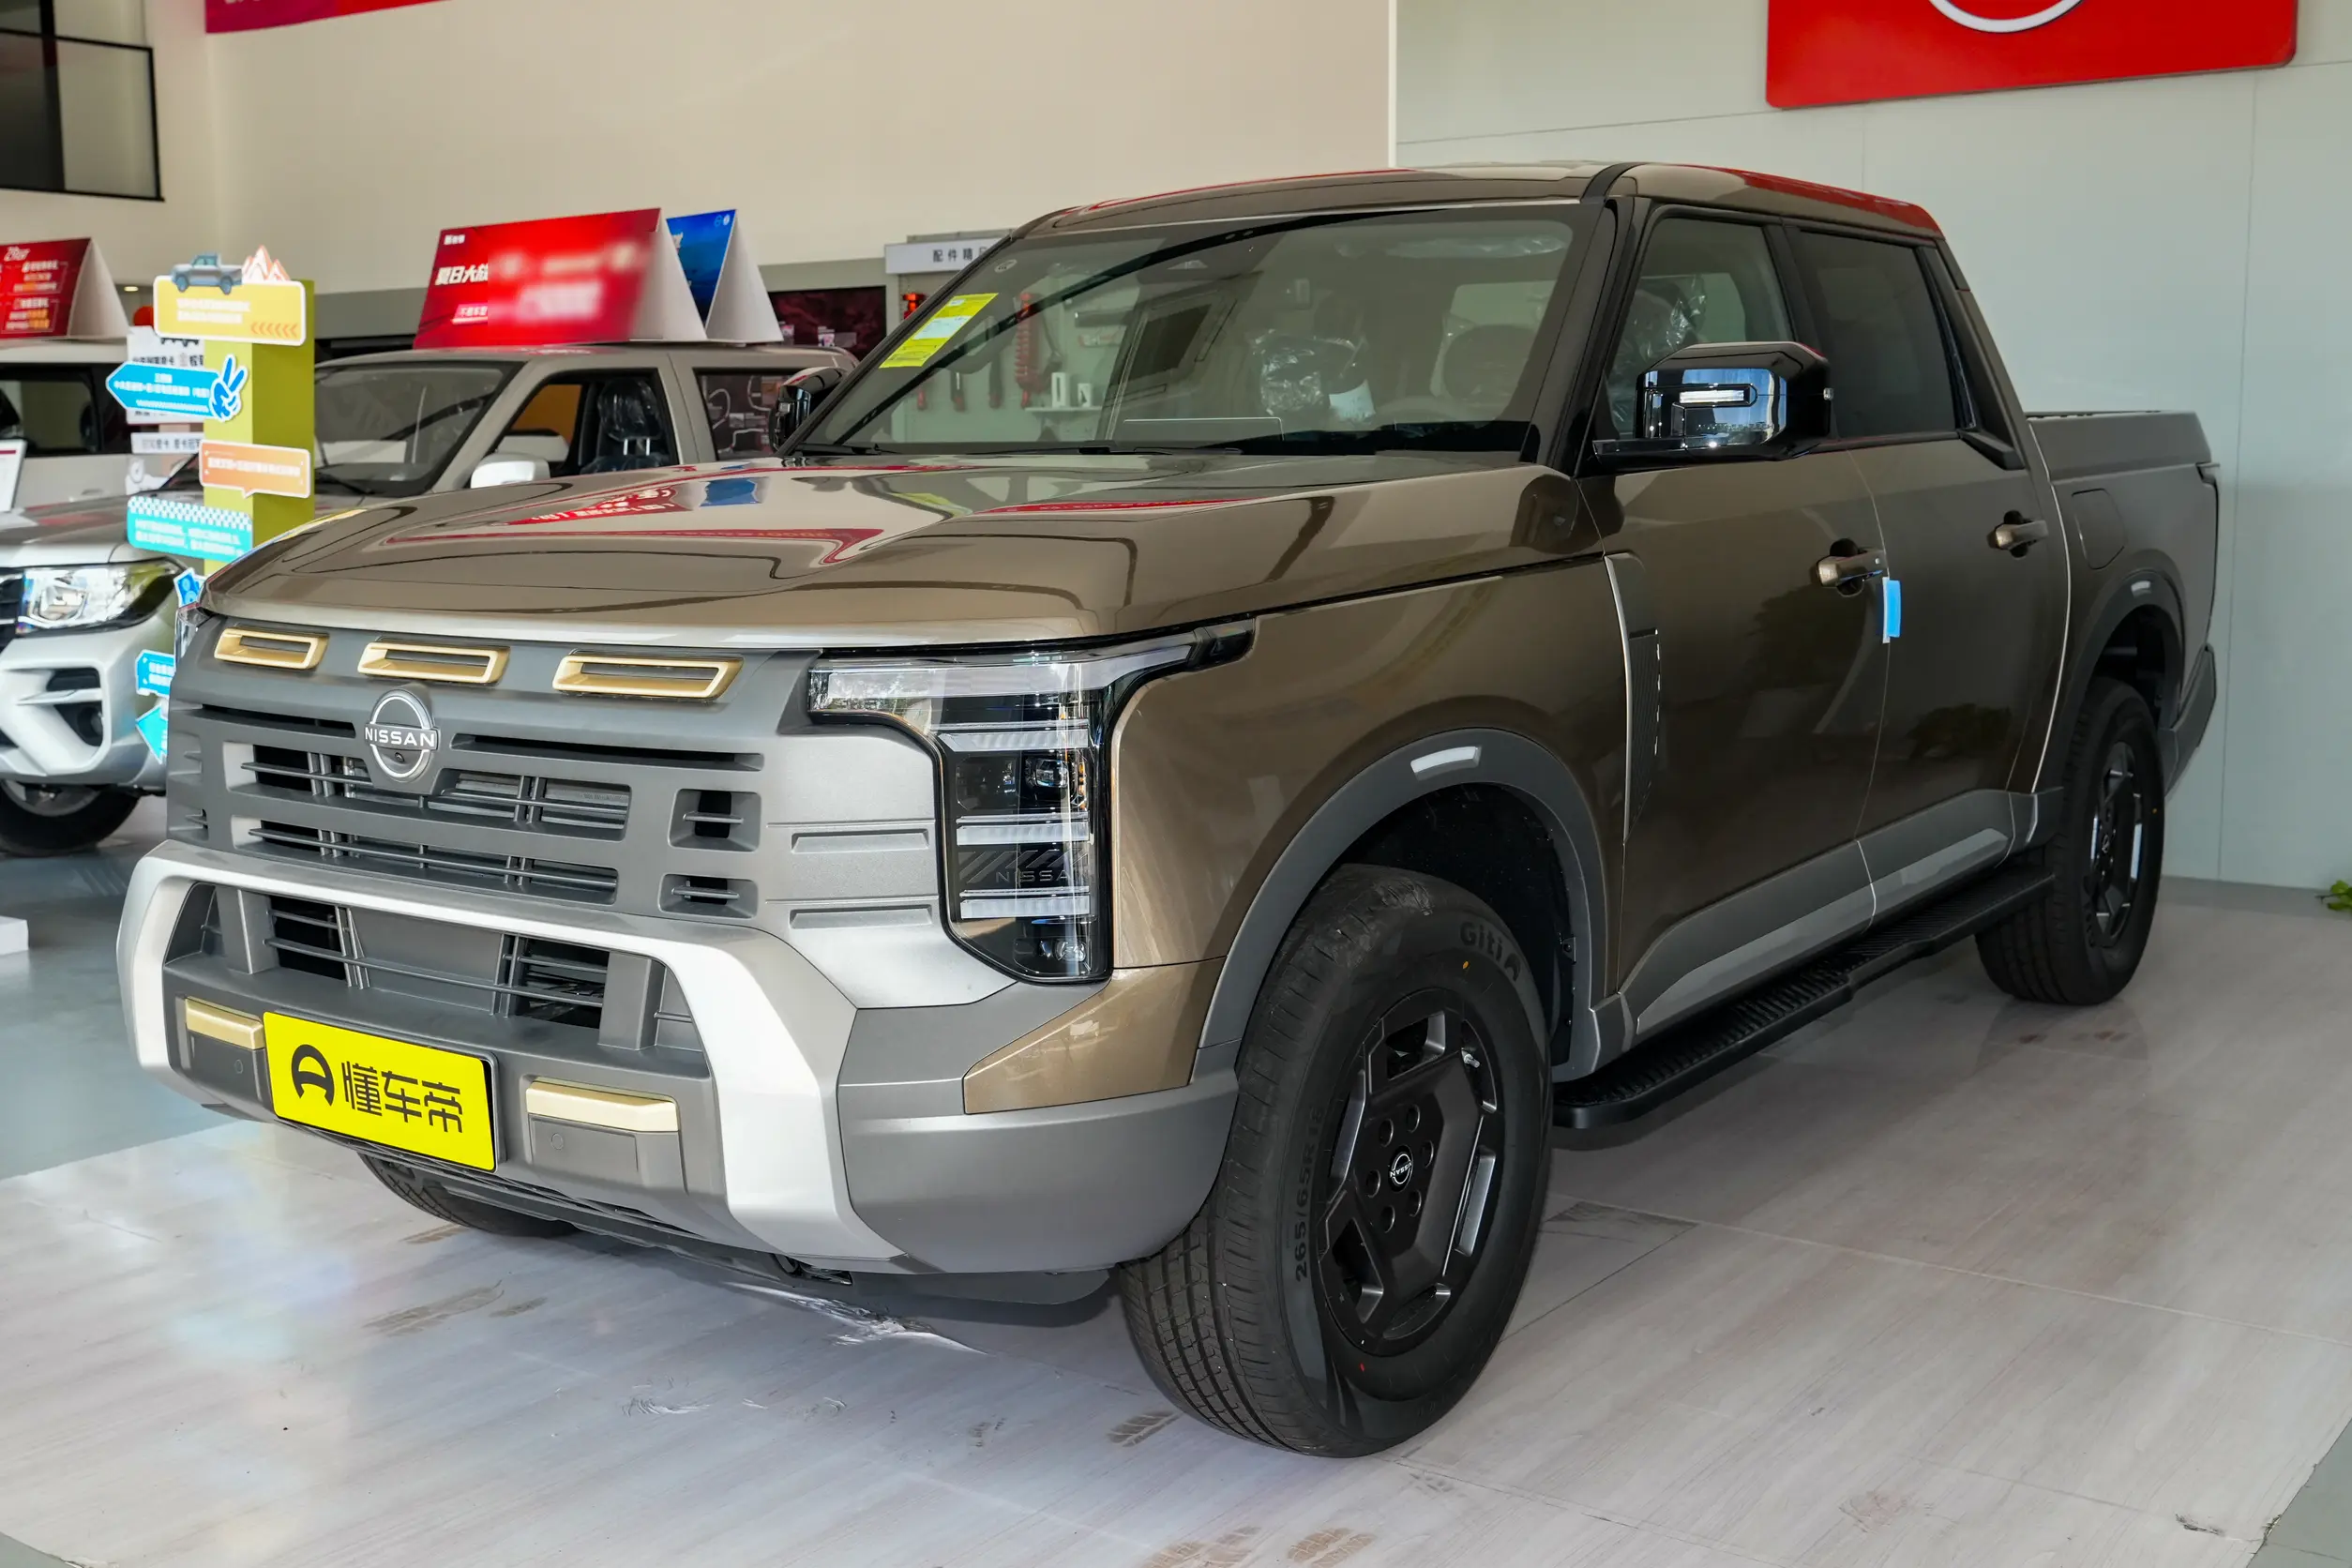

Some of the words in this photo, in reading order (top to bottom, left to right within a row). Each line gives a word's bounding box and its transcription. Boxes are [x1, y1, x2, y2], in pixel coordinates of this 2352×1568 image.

[365, 727, 435, 747] NISSAN
[341, 1061, 463, 1133] 懂车帝
